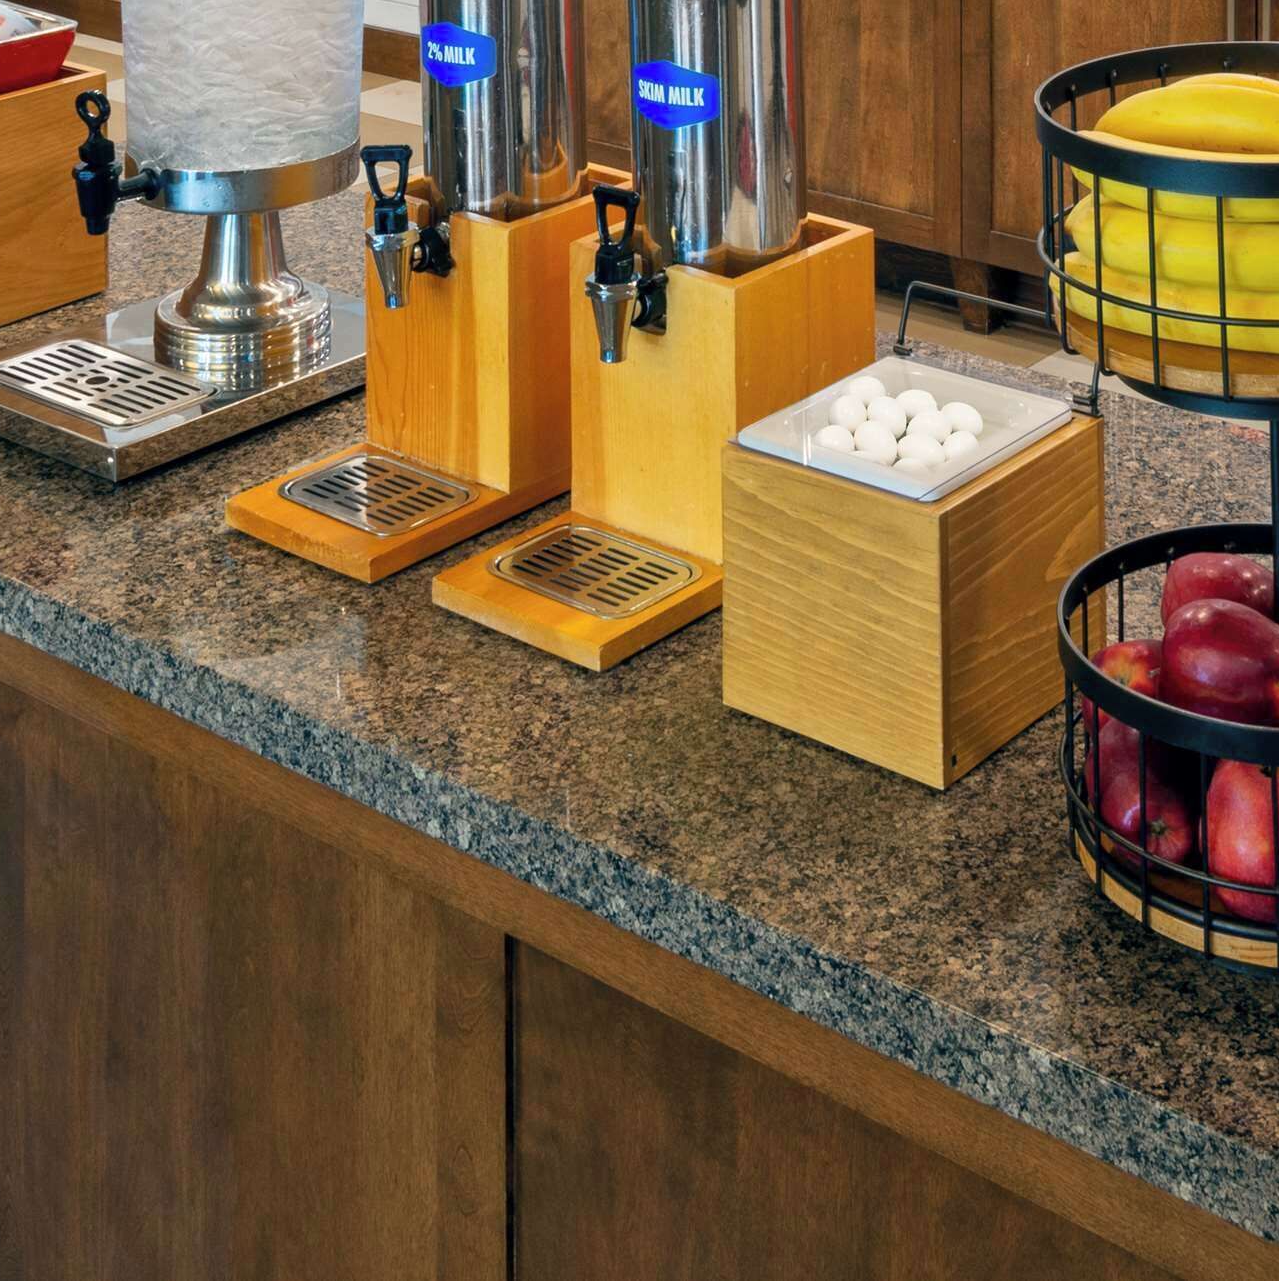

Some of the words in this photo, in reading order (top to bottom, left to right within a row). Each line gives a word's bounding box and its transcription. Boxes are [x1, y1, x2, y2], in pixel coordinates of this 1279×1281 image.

[427, 40, 443, 62] 2%
[443, 45, 476, 65] MILK
[638, 78, 665, 104] SKIM
[668, 85, 705, 107] MILK
